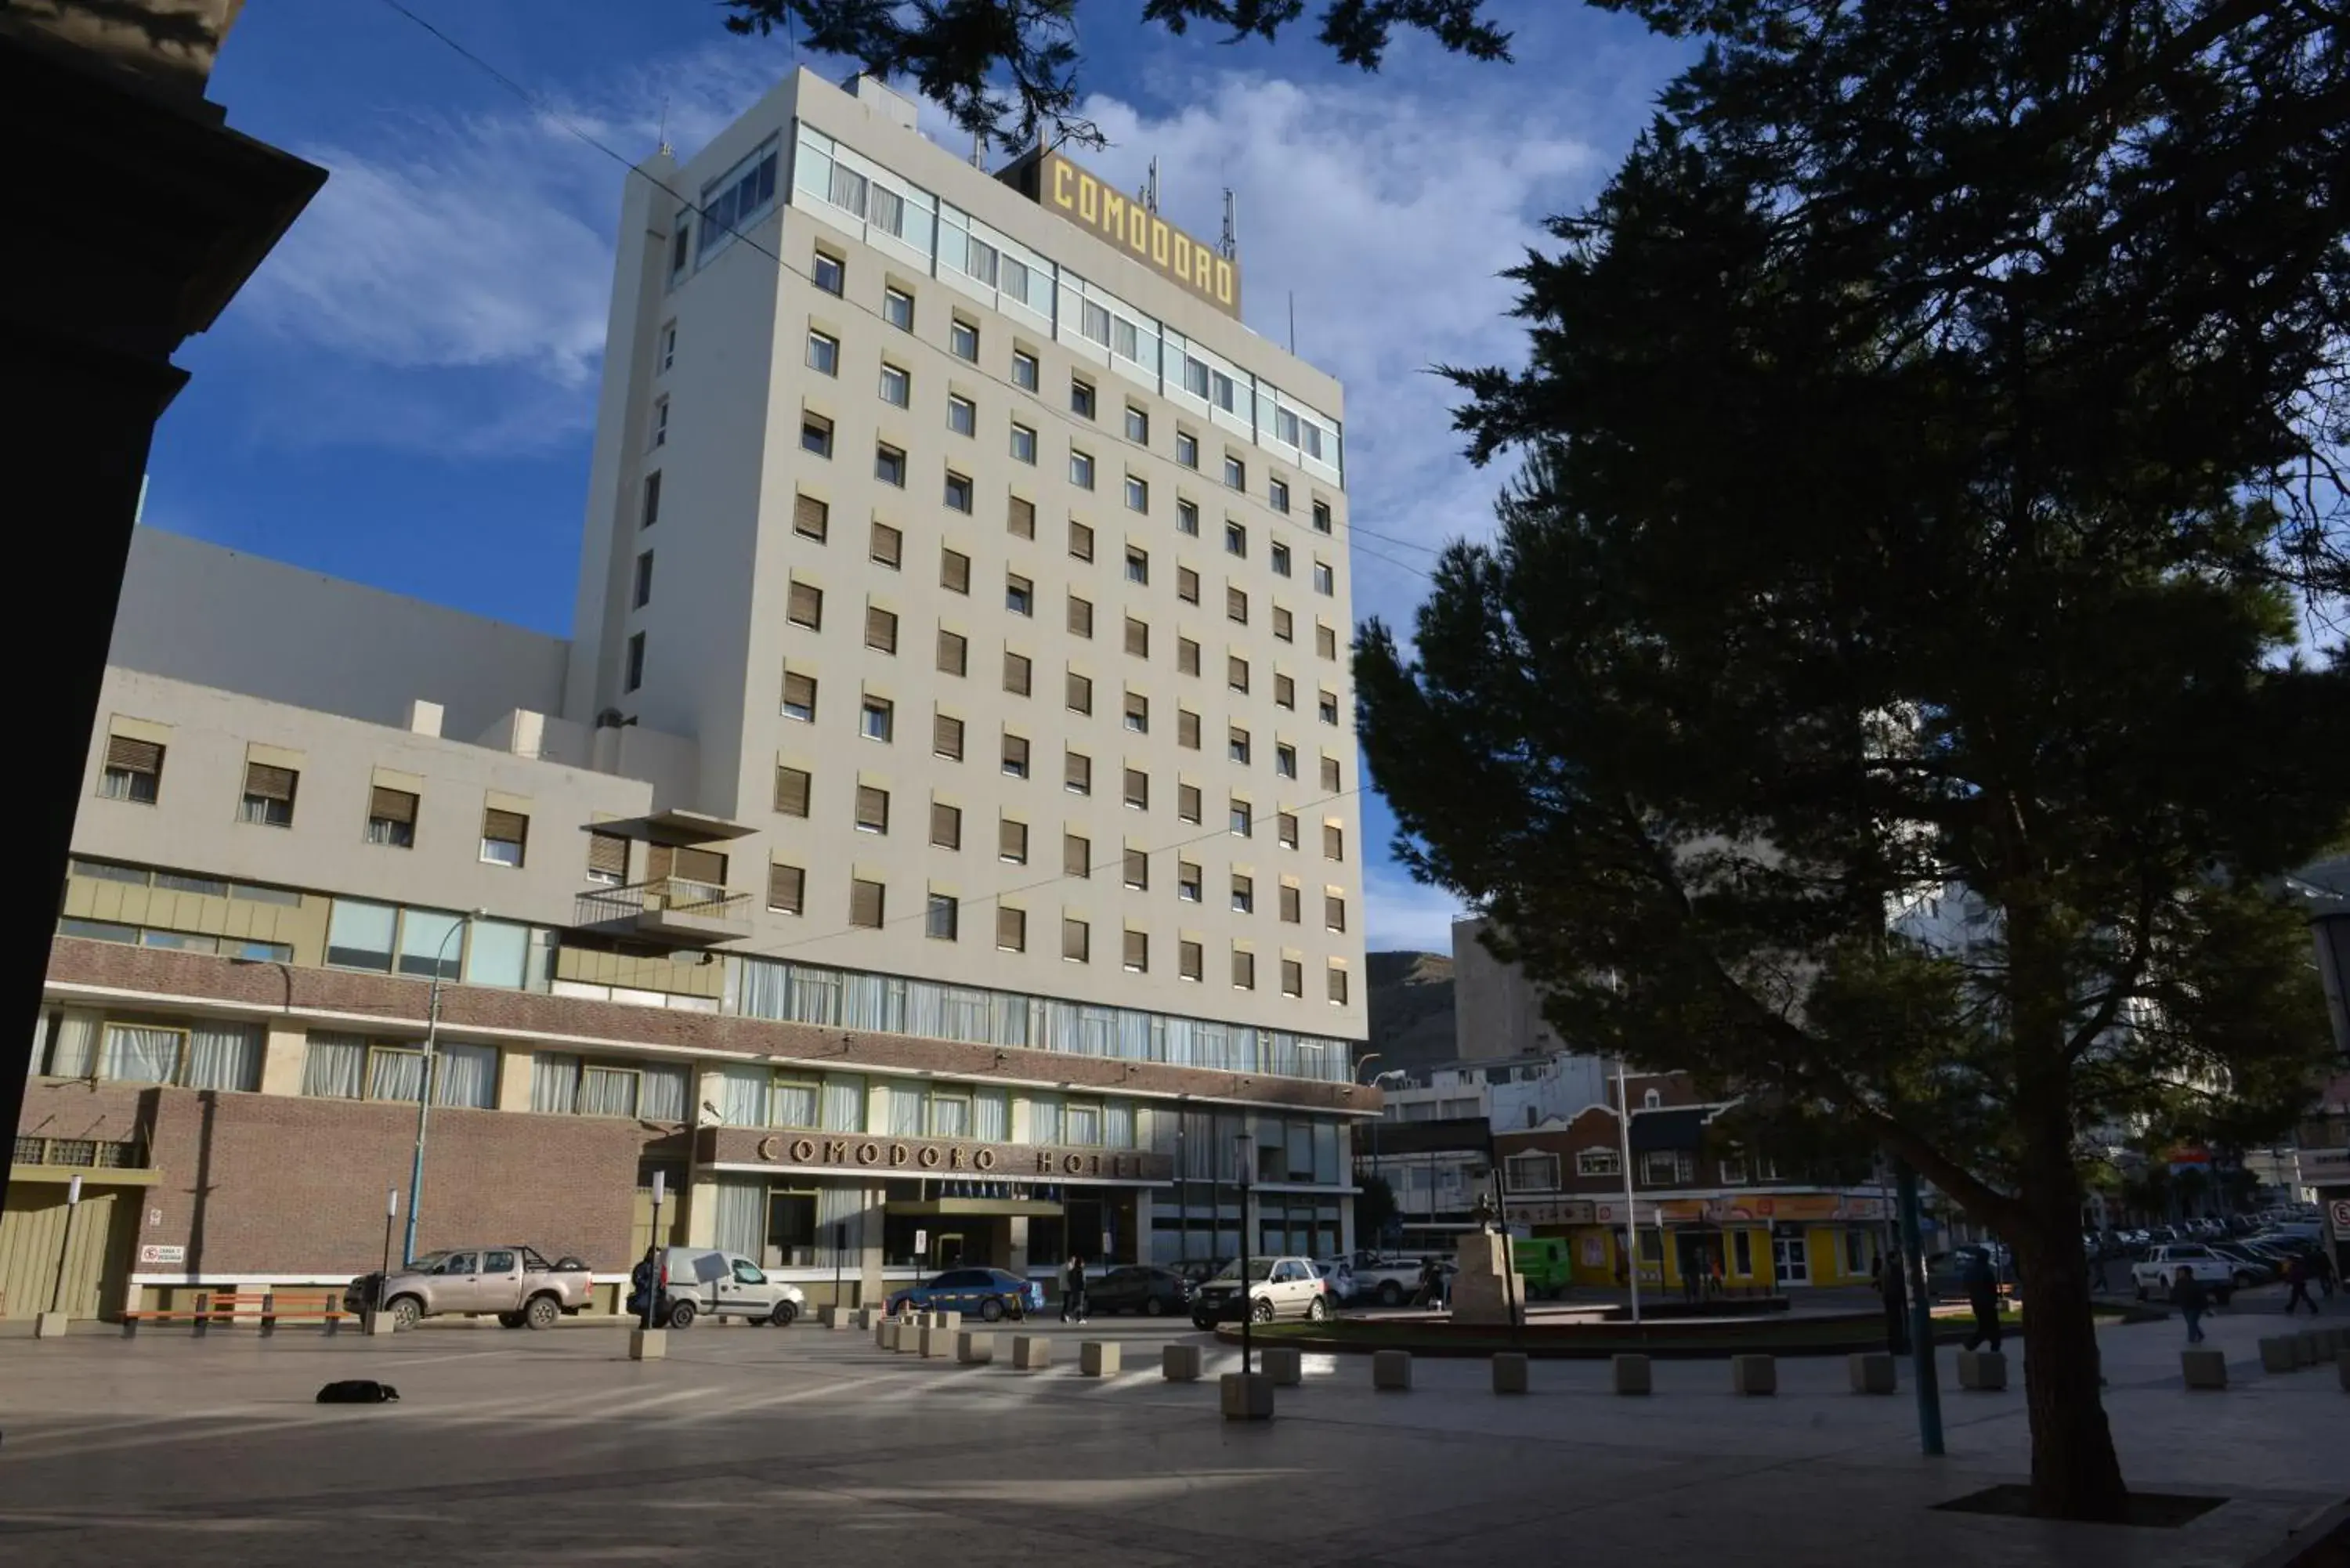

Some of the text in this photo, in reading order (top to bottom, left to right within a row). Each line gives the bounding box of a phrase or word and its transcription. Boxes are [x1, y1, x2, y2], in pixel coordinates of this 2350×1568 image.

[1054, 160, 1232, 305] COMODORO
[758, 1136, 1144, 1179] COMODORO HOTEL
